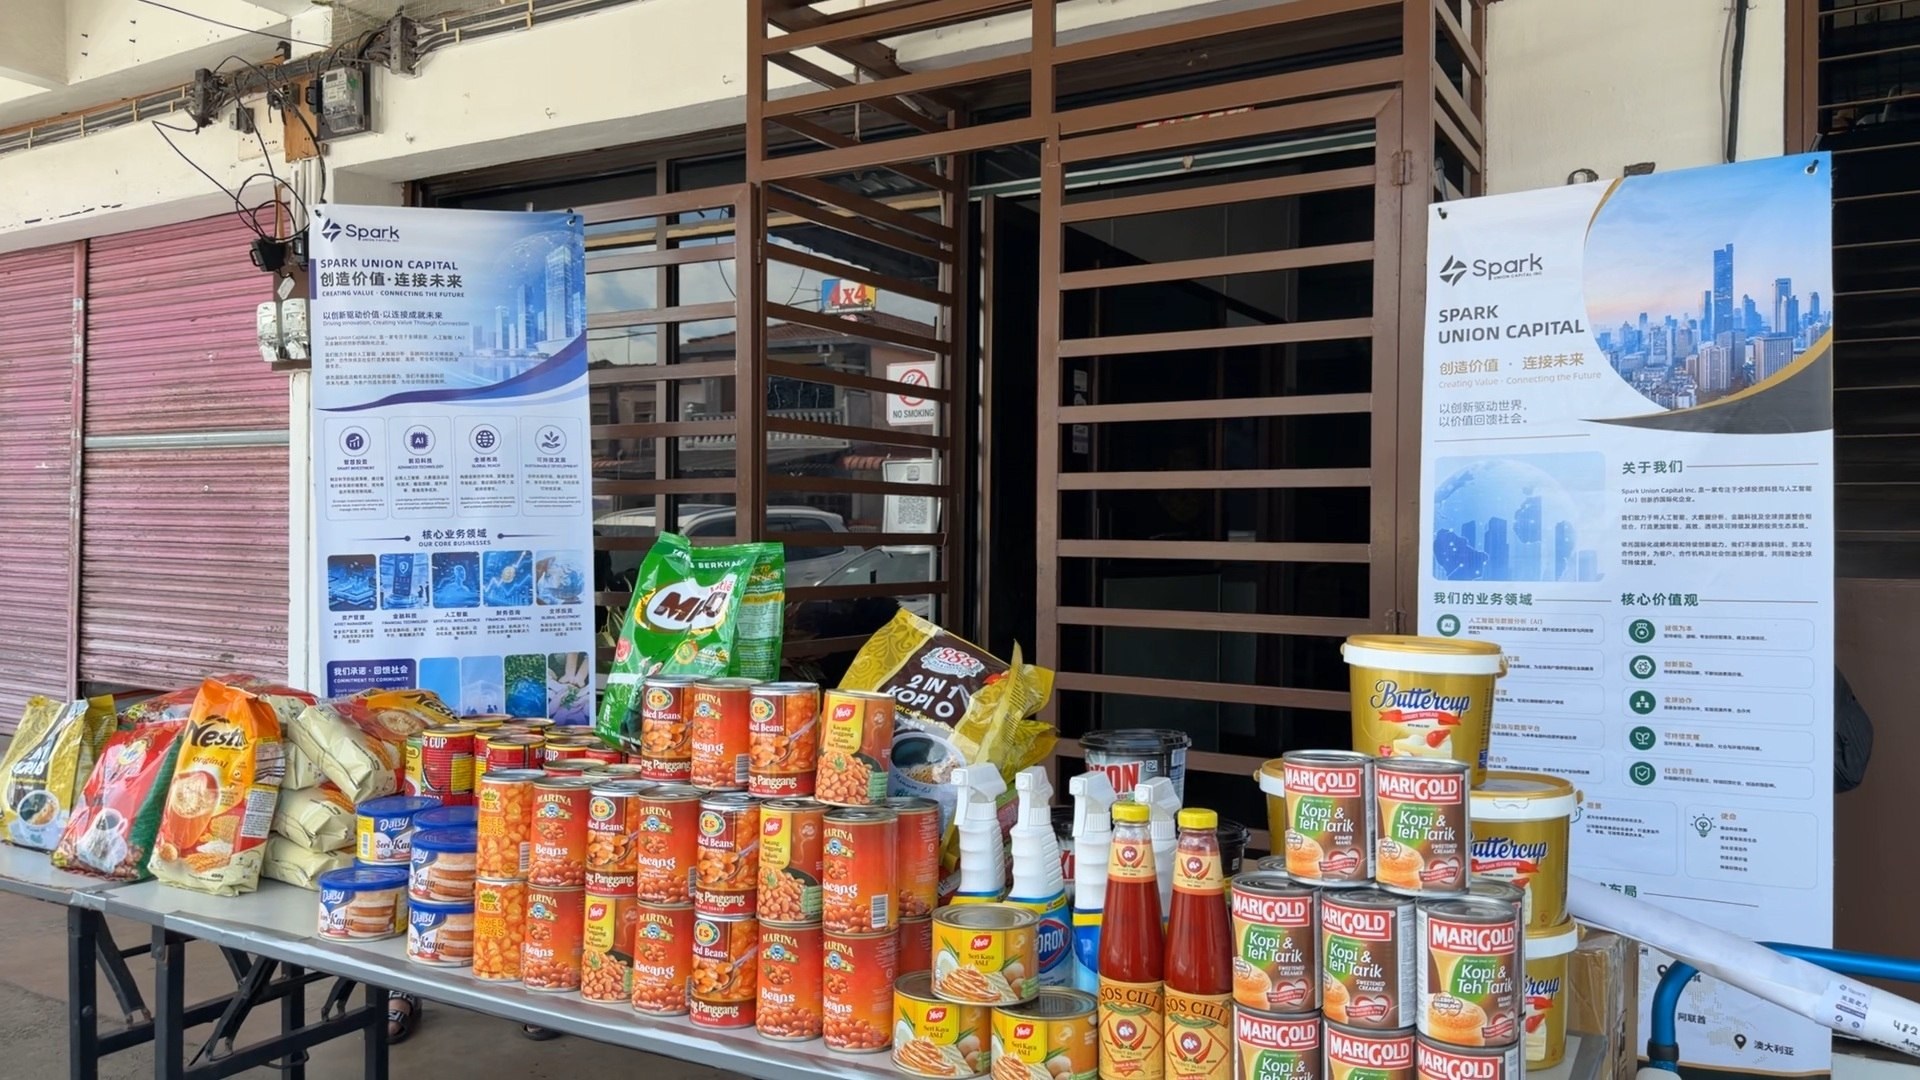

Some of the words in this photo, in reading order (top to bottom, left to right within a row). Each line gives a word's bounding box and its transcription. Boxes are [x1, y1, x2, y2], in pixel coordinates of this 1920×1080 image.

[346, 224, 400, 240] Spark
[320, 259, 357, 268] SPARK
[362, 260, 403, 268] UNION
[407, 260, 458, 270] CAPITAL
[1472, 253, 1543, 280] Spark
[320, 272, 463, 288] 创造价值·连接未来
[1438, 305, 1499, 323] SPARK
[1438, 326, 1500, 345] UNION
[1506, 319, 1585, 339] CAPITAL
[1440, 358, 1499, 376] 创造价值
[1522, 352, 1584, 371] 连接未来
[1438, 379, 1473, 389] Creating
[1475, 377, 1499, 387] Value
[1506, 374, 1555, 385] Connecting
[1557, 373, 1572, 382] the
[1573, 371, 1602, 380] Future
[893, 410, 902, 418] NO
[903, 408, 935, 418] SMOKING
[415, 437, 424, 445] AI
[1622, 461, 1683, 475] 关于我们
[422, 528, 487, 541] 核心业务领域
[1434, 592, 1533, 606] 我们的业务领域
[1621, 593, 1699, 607] 核心价值观
[936, 647, 979, 668] 888
[906, 674, 924, 689] 2
[922, 677, 947, 693] IN
[947, 686, 960, 700] 1
[887, 685, 935, 710] KOPI
[935, 701, 954, 718] O
[1370, 679, 1471, 721] Buttercup
[658, 711, 681, 720] Beans
[761, 723, 784, 733] Beans
[430, 736, 447, 748] CUP
[545, 749, 559, 760] CUP
[653, 759, 692, 773] Panggang
[757, 775, 798, 789] Panggang
[1285, 767, 1356, 793] MARIGOLD
[1379, 774, 1457, 799] MARIGOLD
[1301, 803, 1331, 820] Kopi
[1335, 807, 1344, 819] &
[1400, 811, 1433, 828] Kopi
[1436, 815, 1446, 827] &
[379, 817, 409, 831] Daisy
[599, 821, 624, 831] Beans
[1299, 816, 1318, 830] Teh
[1321, 819, 1354, 833] Tarik
[1397, 823, 1419, 839] Teh
[1422, 827, 1455, 841] Tarik
[535, 844, 568, 857] Beans
[710, 838, 734, 848] Beans
[1471, 836, 1548, 867] uttercup
[594, 873, 634, 887] Panggang
[323, 889, 345, 904] Daisy
[704, 891, 745, 907] Panggang
[1233, 895, 1305, 922] MARIGOLD
[412, 911, 436, 926] Daisy
[1250, 932, 1280, 949] Kopi
[1282, 937, 1293, 949] &
[1433, 924, 1514, 951] MARIGOLD
[704, 946, 728, 958] Beans
[980, 954, 995, 962] Kaya
[1247, 945, 1267, 961] Teh
[1271, 949, 1302, 963] Tarik
[1330, 942, 1358, 961] Kopi
[1360, 951, 1372, 963] &
[1328, 956, 1346, 973] Teh
[1349, 962, 1382, 978] Tarik
[1461, 965, 1495, 982] Kopi
[1498, 966, 1506, 978] &
[1457, 979, 1482, 994] Teh
[1485, 978, 1513, 994] Tarik
[761, 987, 796, 1003] Beans
[1101, 987, 1122, 1000] SOS
[1126, 990, 1158, 1007] CILI
[698, 1001, 739, 1017] Panggang
[1166, 997, 1187, 1012] SOS
[1191, 1001, 1223, 1020] CILI
[935, 1026, 950, 1034] Kaya
[1240, 1017, 1315, 1046] MARIGOLD
[1017, 1048, 1031, 1056] ASLI
[1023, 1042, 1037, 1051] Kaya
[1331, 1035, 1409, 1065] MARIGOLD
[1754, 1040, 1794, 1056] 澳大利亚
[1262, 1057, 1294, 1074] Kopi
[1296, 1061, 1305, 1073] &
